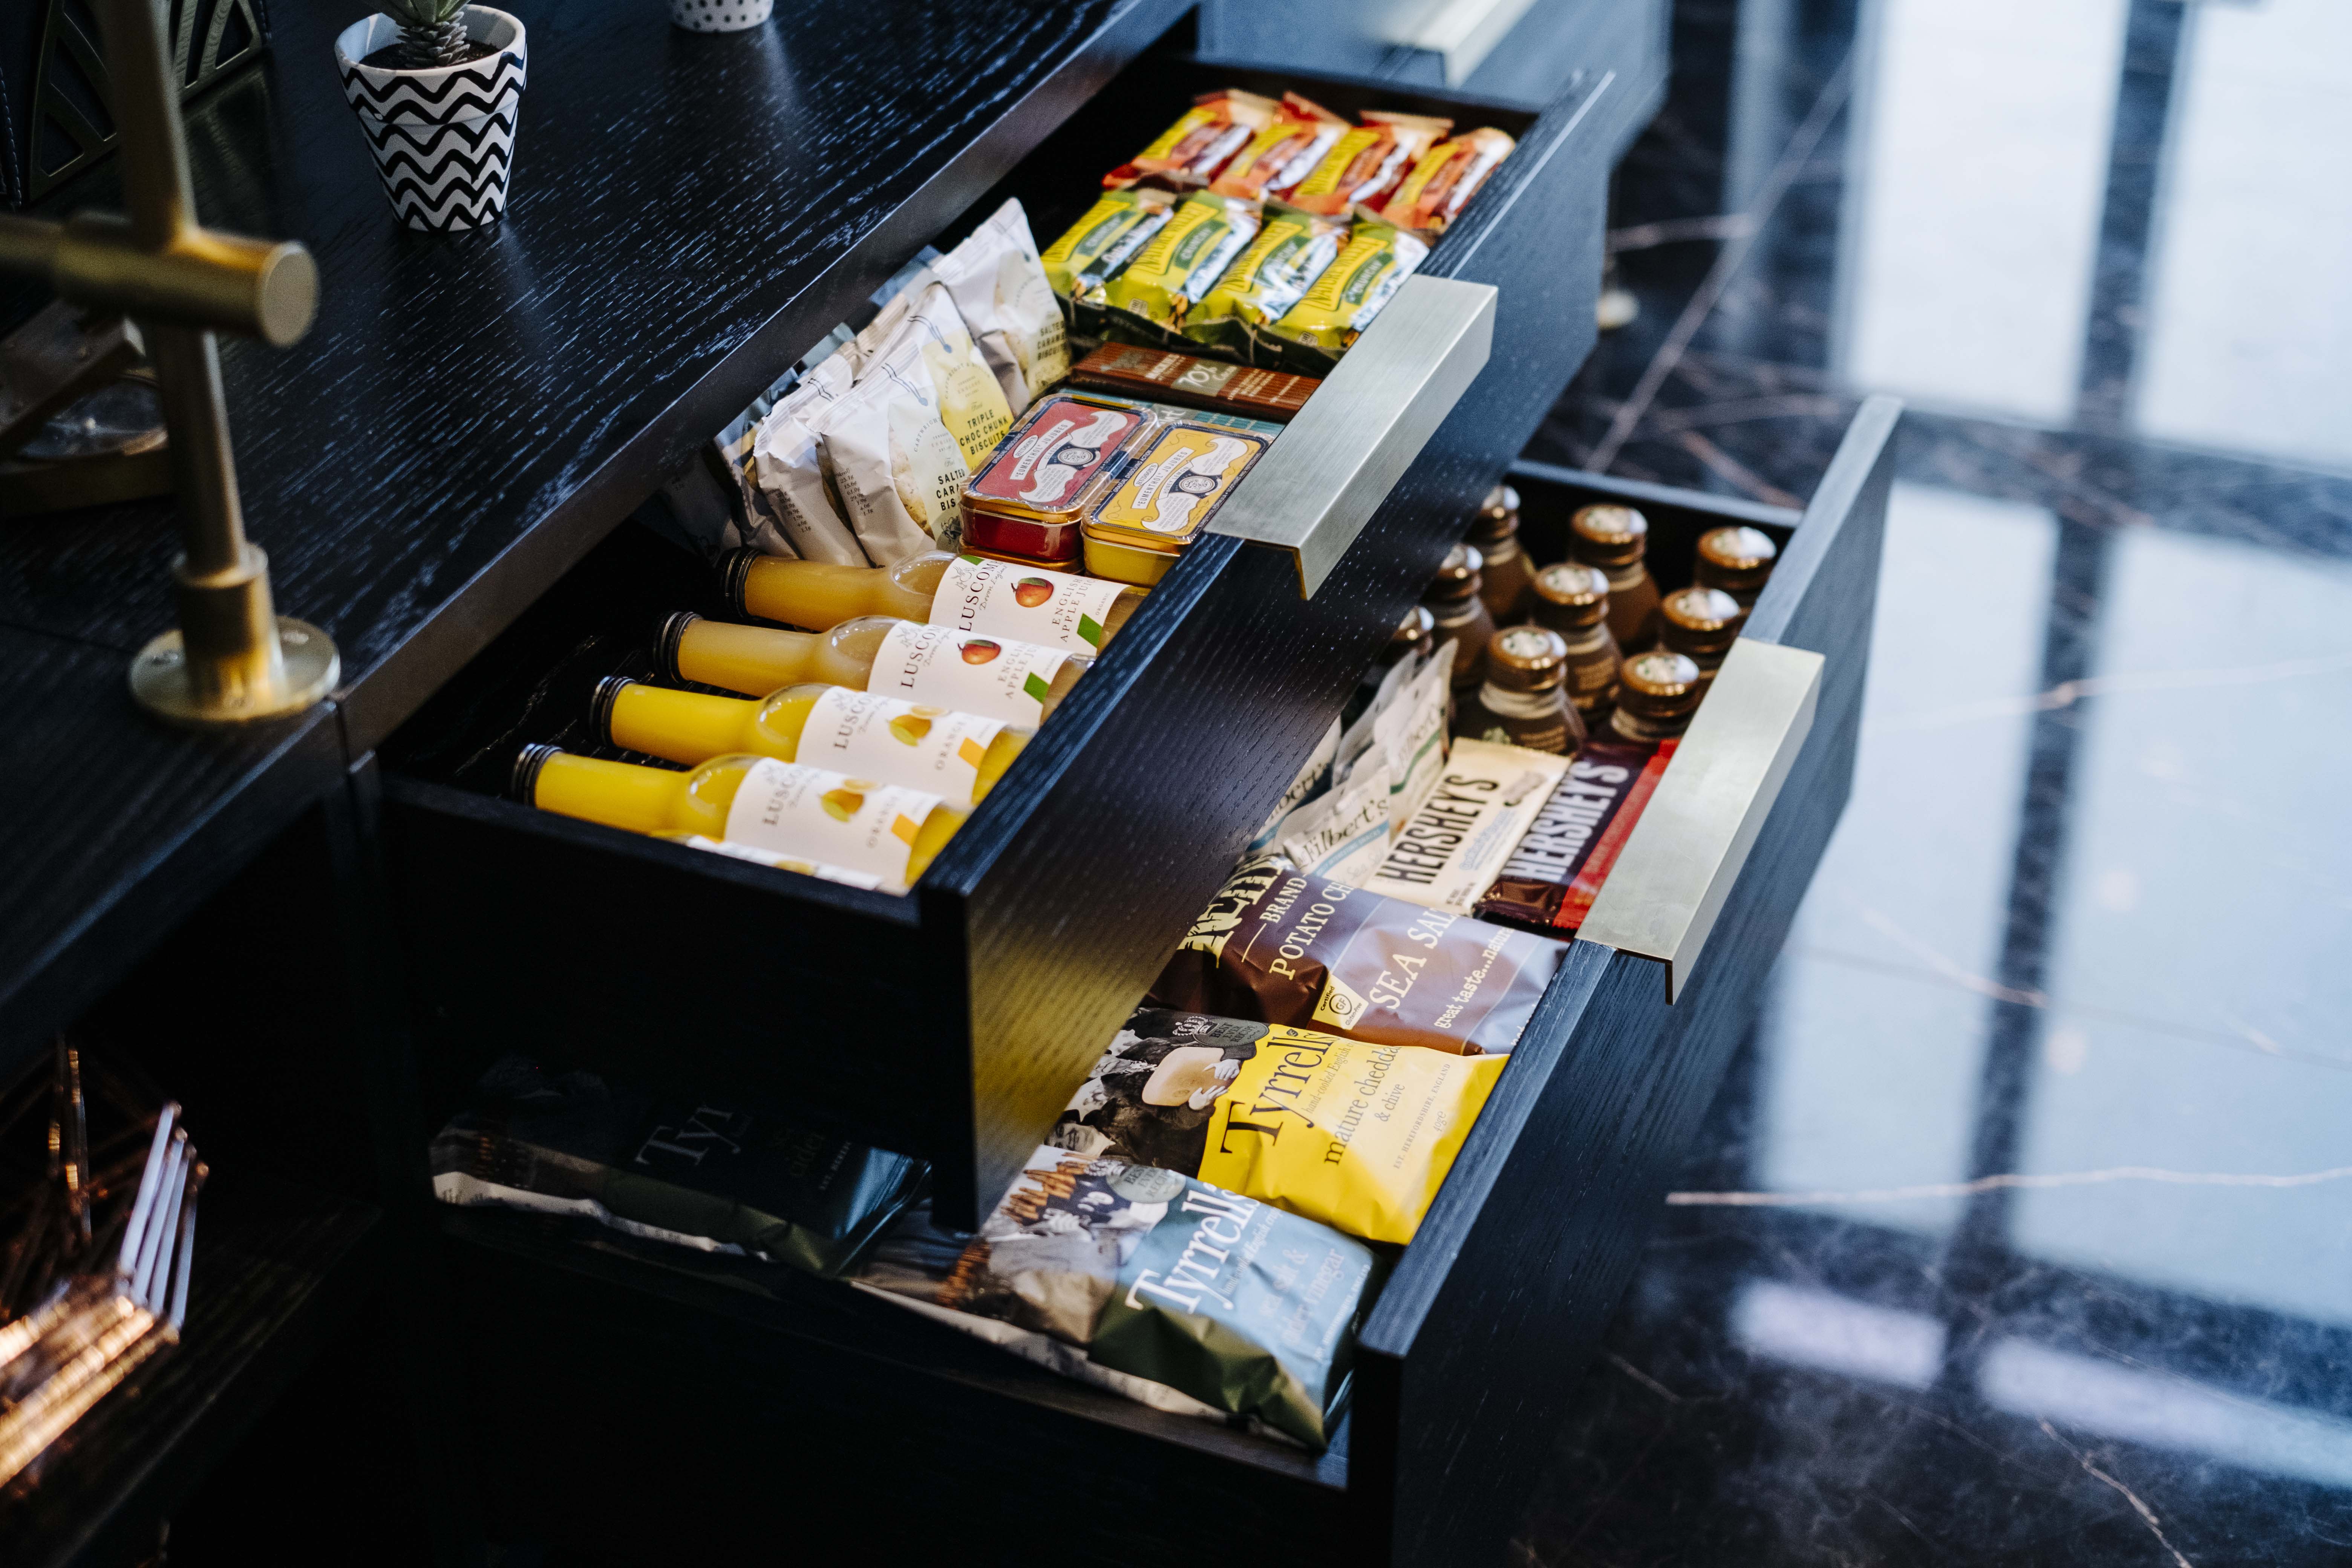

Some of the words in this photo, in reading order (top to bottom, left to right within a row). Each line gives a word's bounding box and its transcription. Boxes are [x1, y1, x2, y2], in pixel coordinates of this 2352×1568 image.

[960, 430, 981, 446] CHOC
[983, 415, 1009, 434] CHUNK
[968, 409, 994, 429] TRIPLE
[970, 430, 1006, 455] BISCUITS
[992, 448, 1007, 464] GRADUAL
[1021, 423, 1033, 434] ACTION
[1015, 436, 1037, 457] HUDSON'S
[1042, 424, 1068, 444] JUJUBES
[1113, 478, 1128, 492] GRADUAL
[1125, 461, 1143, 479] DISSOLVING
[1140, 450, 1152, 461] ACTION
[1136, 464, 1157, 485] HUDSON'S
[1163, 451, 1187, 472] JUJUBES
[938, 468, 965, 485] SALTED
[1164, 480, 1173, 494] HONEY
[1172, 466, 1189, 480] LEMON
[936, 483, 960, 499] CARA
[940, 498, 957, 511] BIS
[959, 560, 1004, 632] LUSCOMB
[1052, 579, 1083, 626] ENGLISH
[1060, 599, 1080, 642] APPLE
[901, 626, 944, 690] LUSCOM
[833, 697, 873, 750] LUSCO
[1375, 773, 1500, 885] HERSHEY'S
[1260, 877, 1308, 923] BRAND
[1269, 903, 1335, 981] POTATO
[1322, 882, 1355, 901] CH
[1369, 953, 1427, 1010] SEA
[1320, 985, 1335, 1012] Certified
[1335, 998, 1346, 1010] GF
[1344, 1002, 1363, 1026] Gluten-Free
[1433, 1004, 1464, 1029] great
[1211, 1022, 1234, 1038] BEST
[1223, 1025, 1242, 1039] EVER
[1302, 1069, 1337, 1115] hand-cooked
[1327, 1045, 1351, 1073] English
[1323, 1099, 1369, 1165] mature
[1354, 1046, 1403, 1096] chedda
[1381, 1083, 1405, 1112] chive
[1374, 1112, 1391, 1122] &
[1393, 1155, 1405, 1170] EST.
[1401, 1095, 1436, 1152] HEREFORDSHIRE,
[1431, 1063, 1451, 1094] ENGLAND
